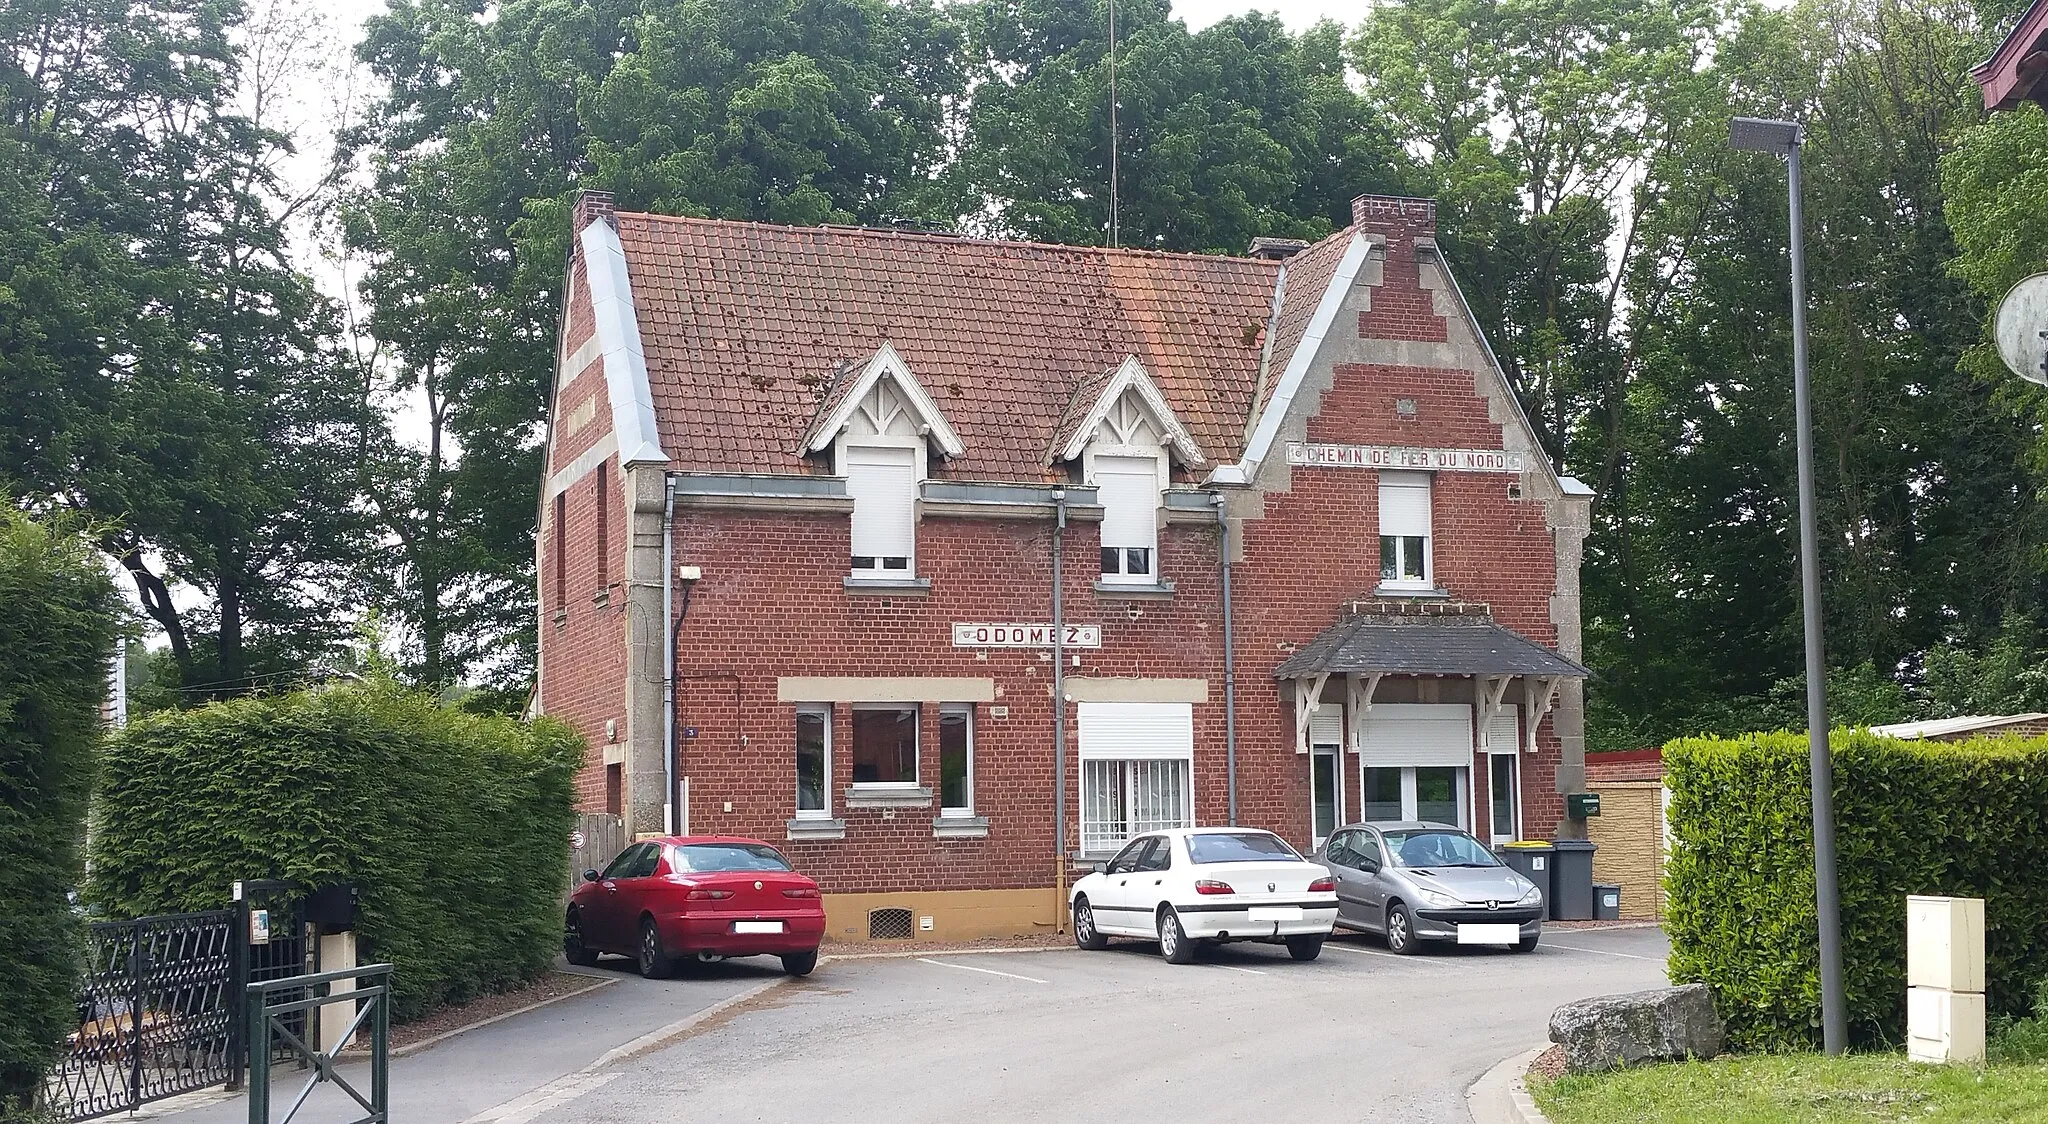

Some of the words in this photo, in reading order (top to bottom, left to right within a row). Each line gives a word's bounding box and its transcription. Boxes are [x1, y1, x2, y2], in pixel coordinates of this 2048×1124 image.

[1307, 448, 1362, 463] CHEMIN
[1373, 450, 1390, 464] DE
[1401, 451, 1428, 466] FER
[1439, 453, 1456, 467] DU
[1467, 454, 1504, 468] NORD
